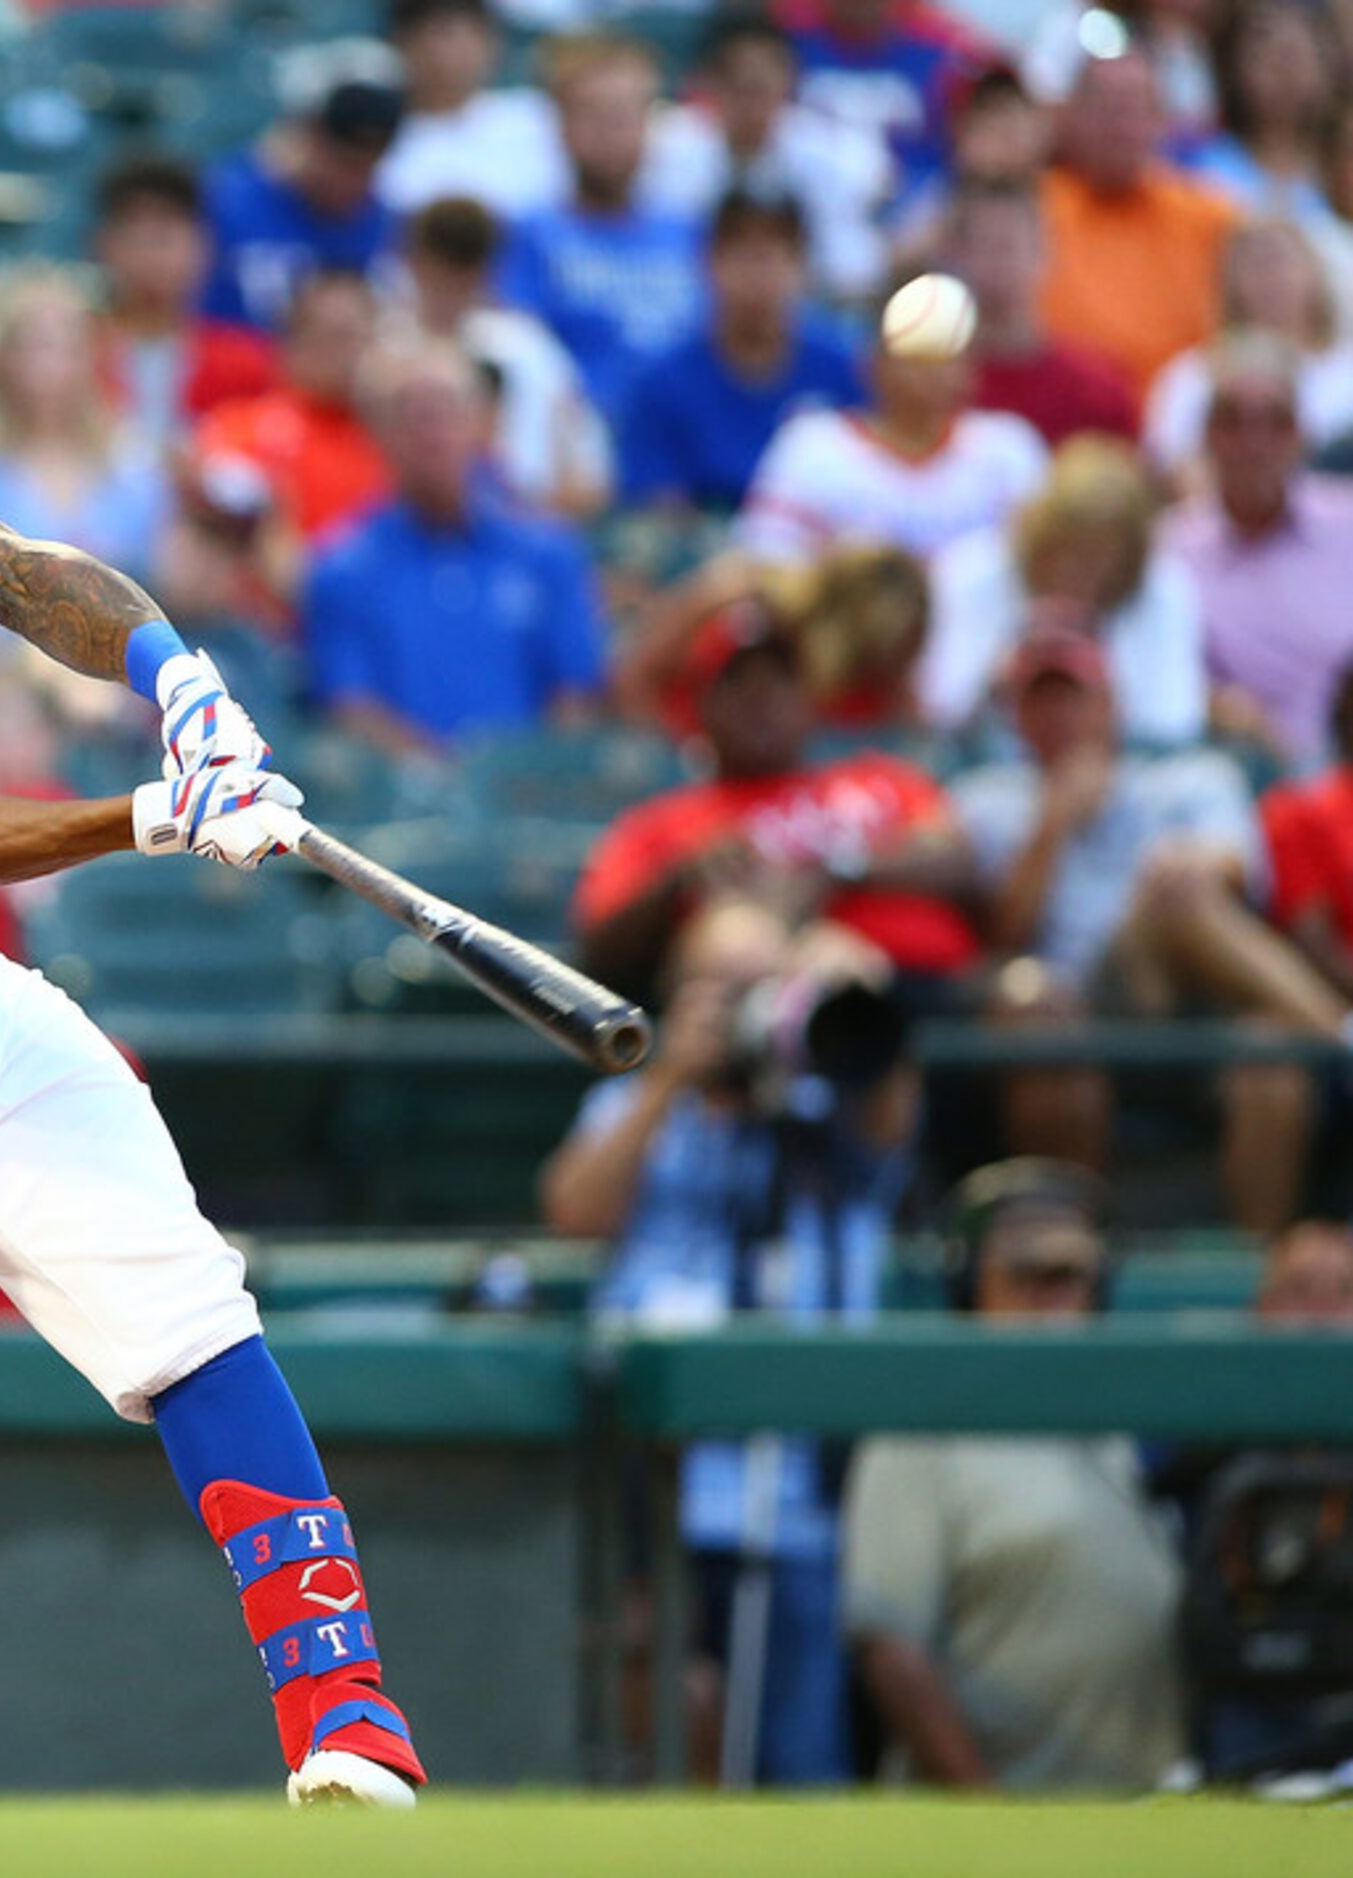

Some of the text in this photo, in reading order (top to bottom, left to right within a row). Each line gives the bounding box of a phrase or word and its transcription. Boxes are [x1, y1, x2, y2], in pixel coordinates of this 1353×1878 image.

[252, 1533, 272, 1565] 3
[297, 1514, 329, 1550] T
[282, 1637, 301, 1667] 3
[317, 1620, 349, 1658] T
